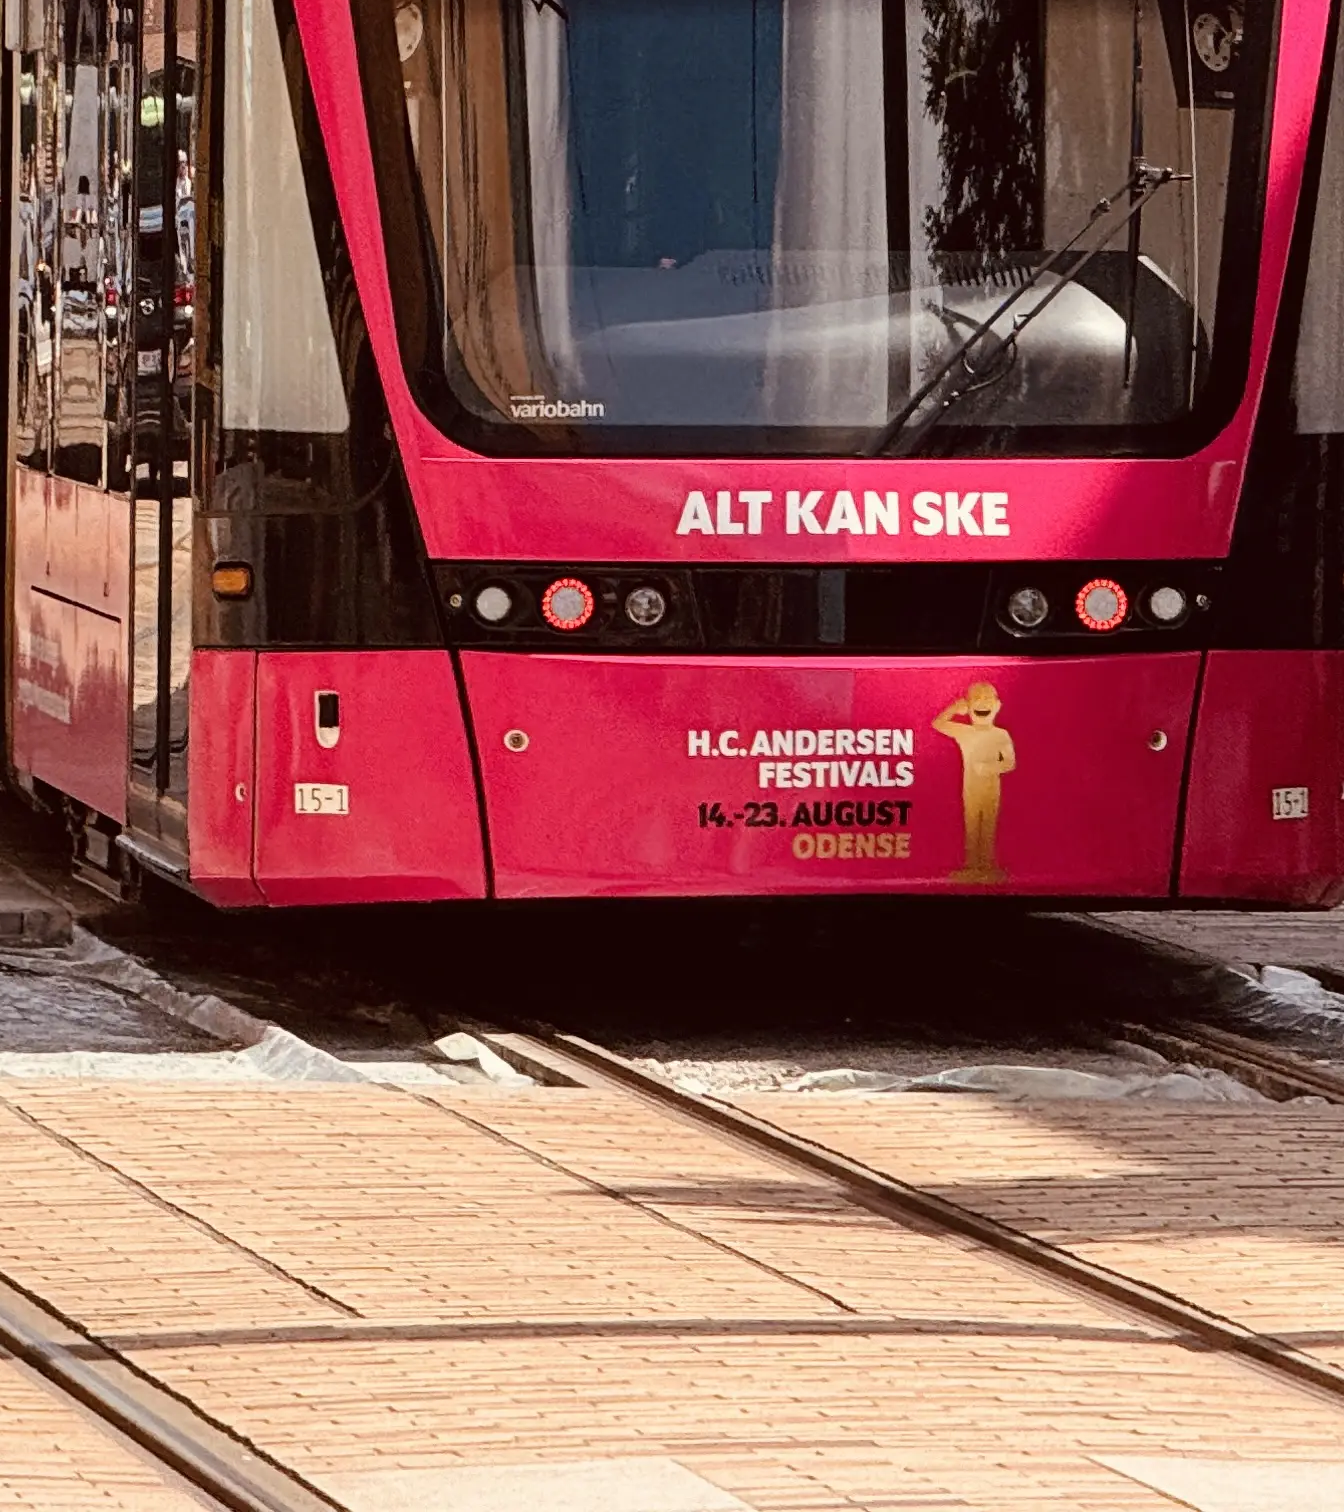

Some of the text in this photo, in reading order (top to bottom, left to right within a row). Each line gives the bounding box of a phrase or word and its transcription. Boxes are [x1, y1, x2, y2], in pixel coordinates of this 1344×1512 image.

[510, 400, 604, 418] variobahn
[676, 490, 1011, 536] ALT KAN SKE
[758, 761, 915, 788] FESTIVALS
[298, 787, 347, 812] 15-1
[698, 800, 913, 828] 14.-23. AUGUST
[792, 833, 912, 859] ODENSE
